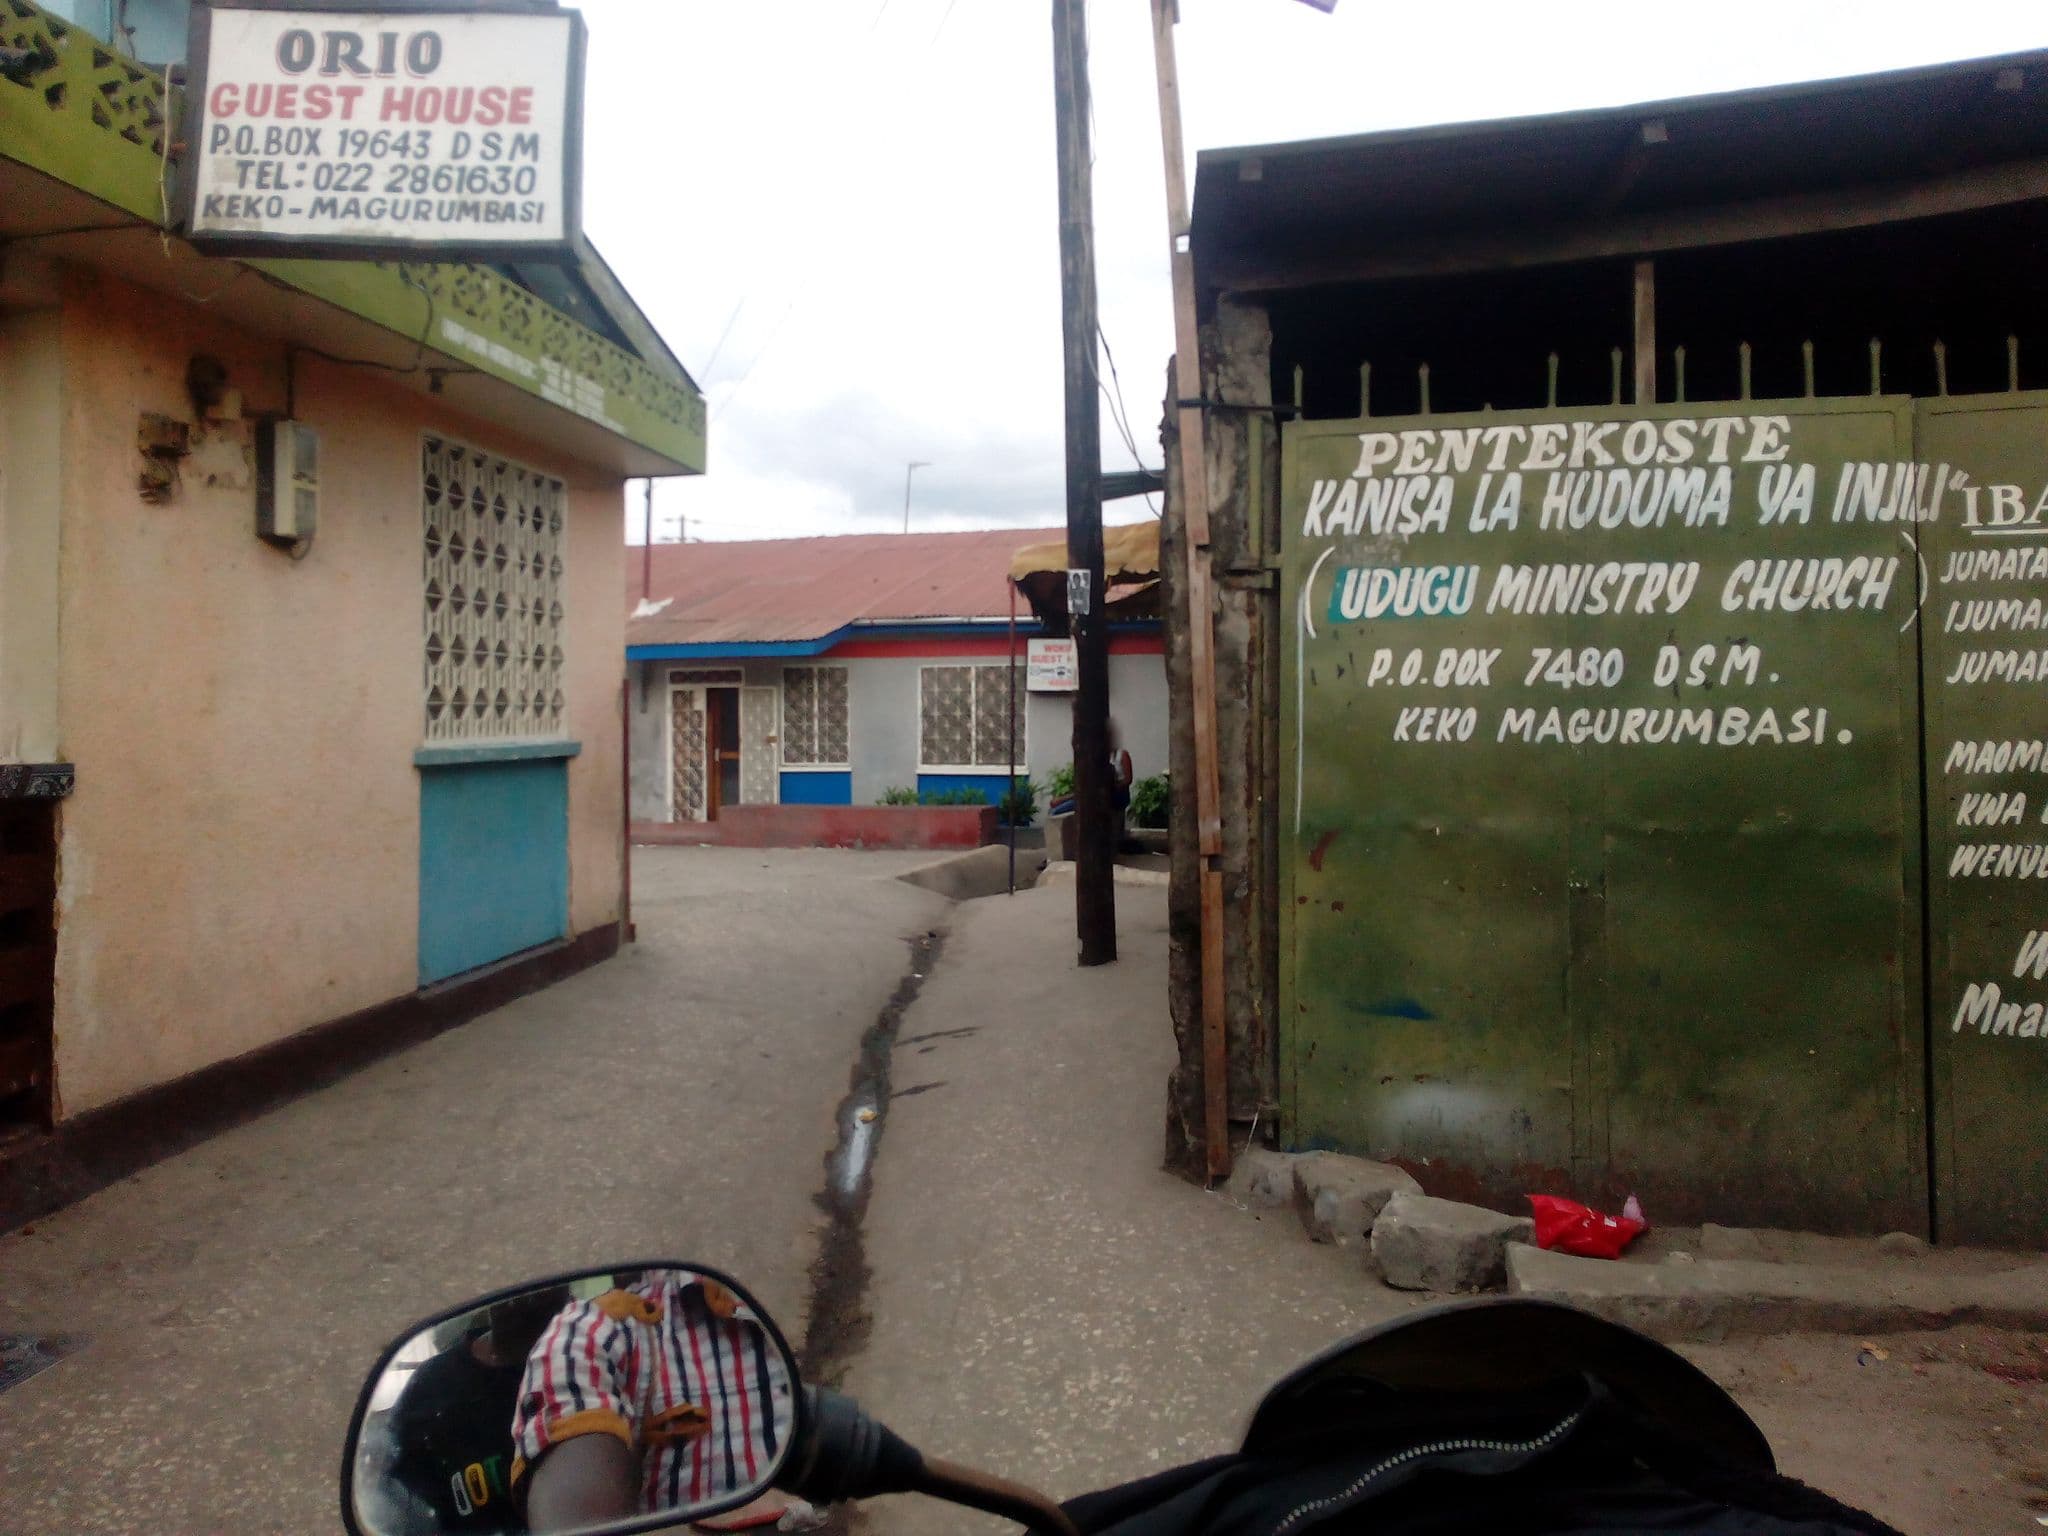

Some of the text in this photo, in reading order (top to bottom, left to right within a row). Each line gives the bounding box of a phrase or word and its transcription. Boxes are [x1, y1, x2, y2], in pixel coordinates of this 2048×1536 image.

[276, 28, 442, 79] ORIO
[210, 83, 534, 126] GUEST HOUSE
[338, 129, 432, 160] 19643
[385, 163, 537, 197] 2861630
[1352, 415, 1792, 477] PENTEKOSTE
[1303, 475, 1455, 537] KANISA
[1468, 471, 1523, 533] LA
[1539, 465, 1733, 530] HUDUMA
[1758, 463, 1816, 525] YA
[1486, 562, 1700, 615] MINISTRY
[1524, 646, 1624, 689] 7480
[1393, 707, 1477, 742] KEKO
[1956, 792, 2027, 827] KWA
